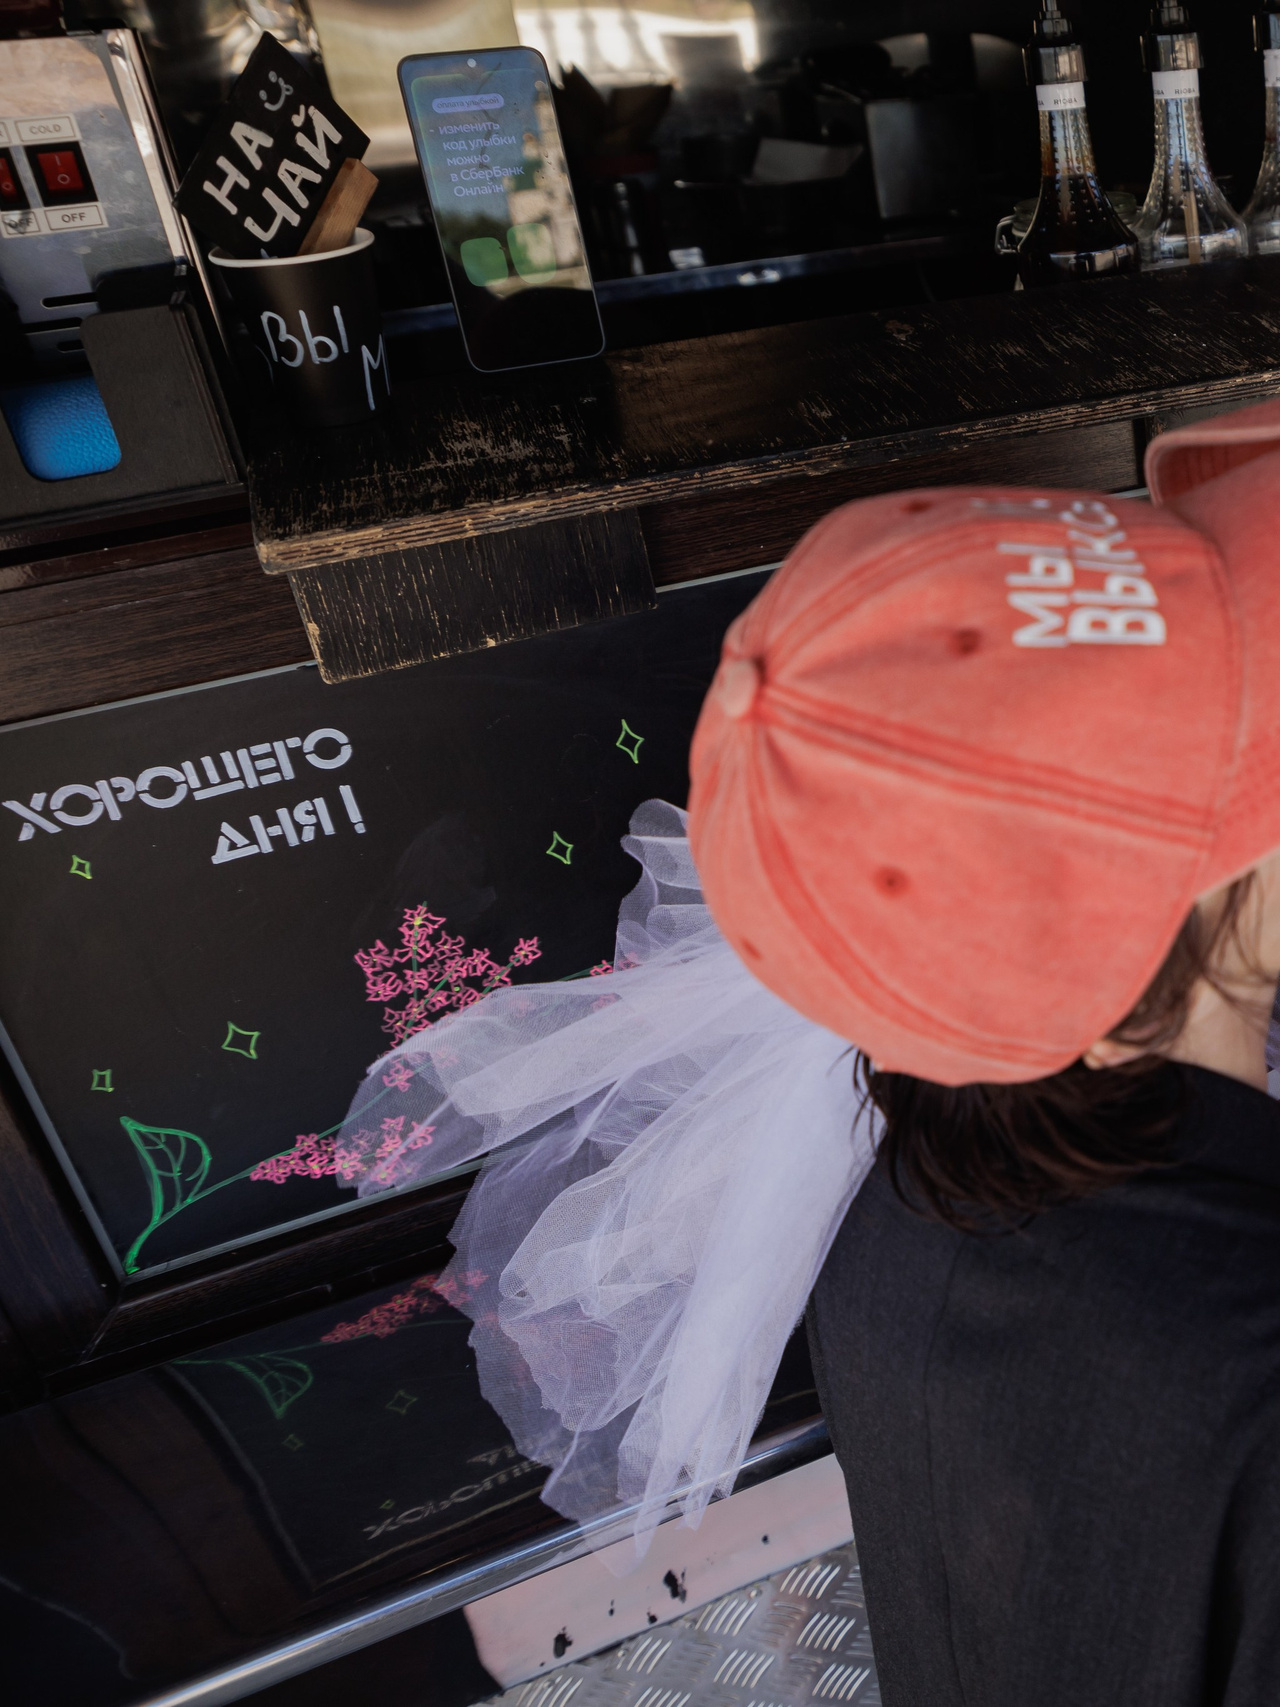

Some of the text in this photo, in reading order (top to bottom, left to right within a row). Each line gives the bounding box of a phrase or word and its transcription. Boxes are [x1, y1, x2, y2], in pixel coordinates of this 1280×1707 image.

[437, 97, 499, 109] оплата улыбкой
[29, 123, 62, 135] COLD
[438, 121, 500, 135] изменить
[442, 134, 516, 152] код улыбки
[203, 120, 274, 216] НА
[446, 154, 490, 167] можно
[243, 103, 345, 243] ЧАЙ
[450, 166, 525, 182] в СберБанк
[453, 181, 505, 198] Онлайн
[61, 211, 87, 224] OFF
[1, 727, 354, 842] ХОРОШЕГО
